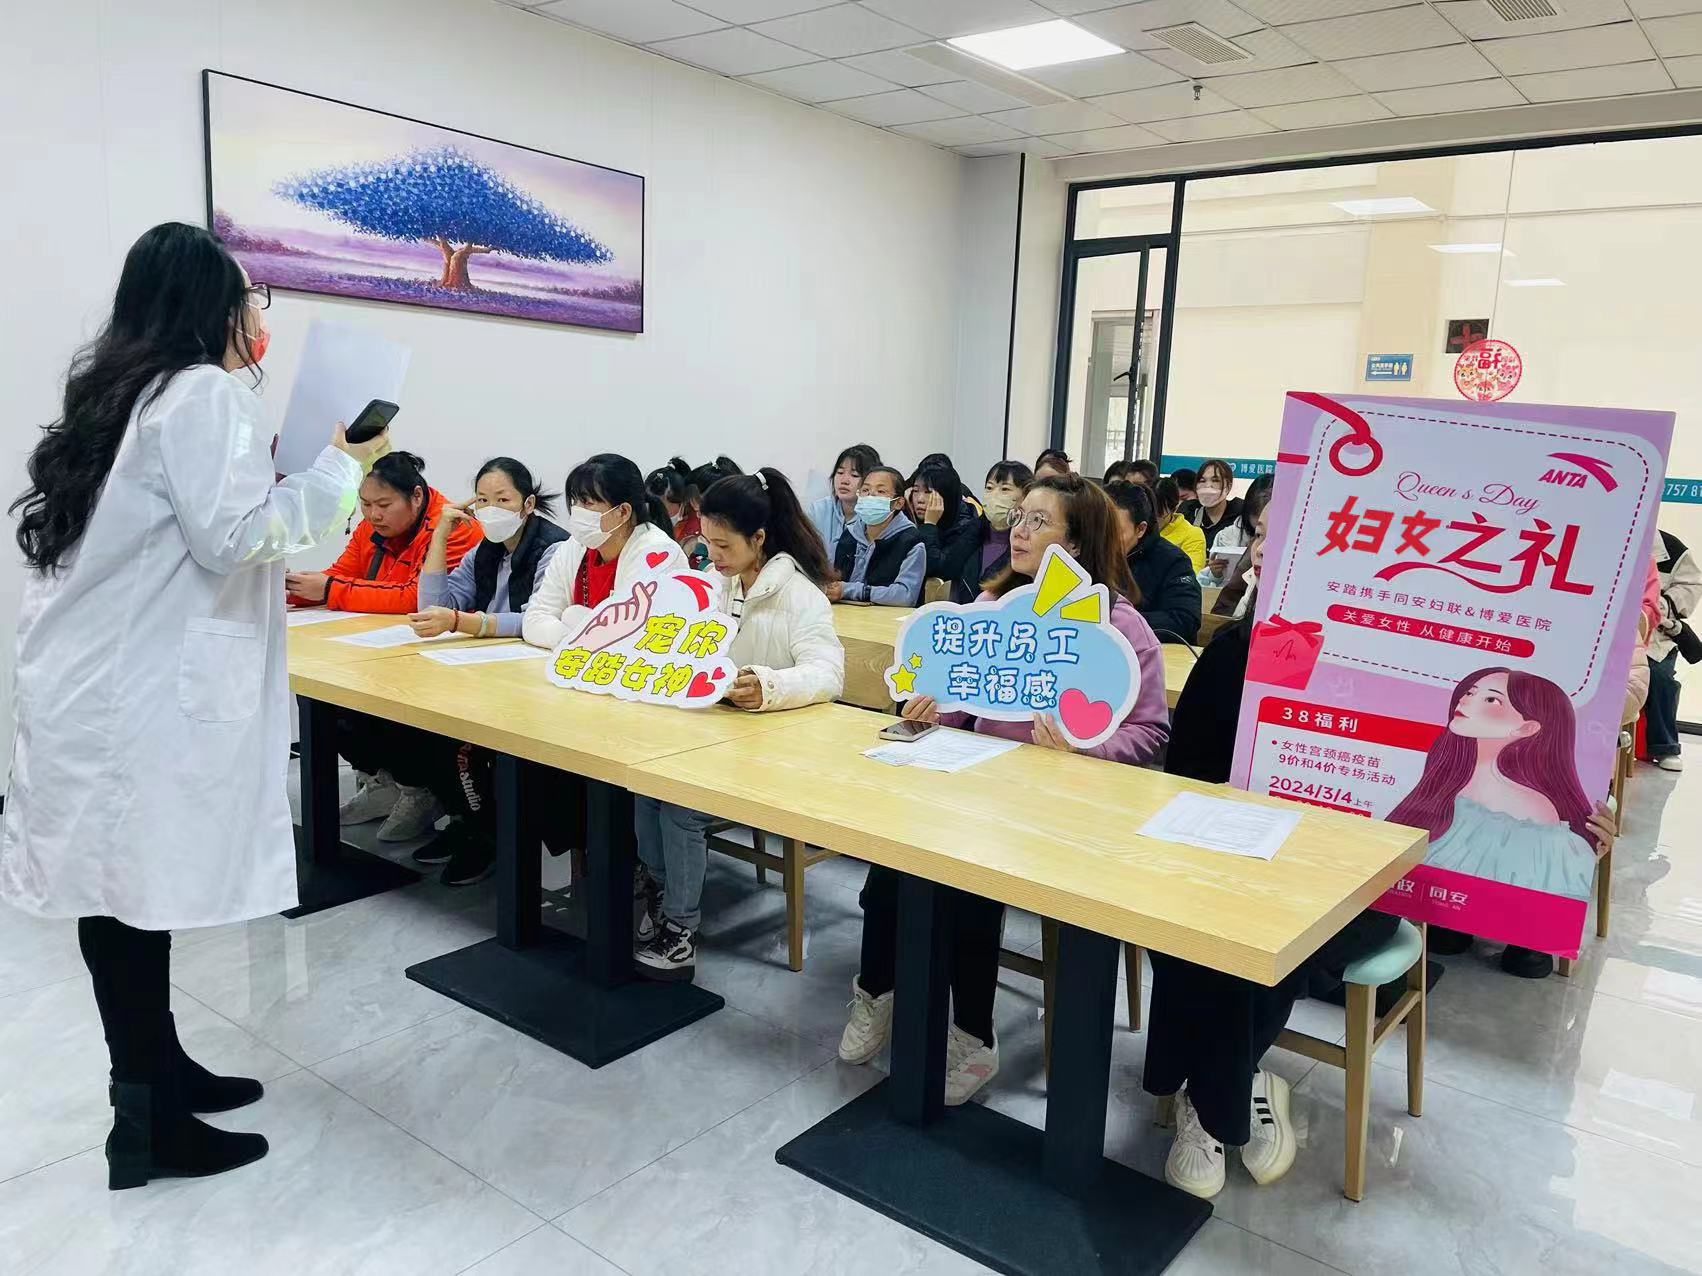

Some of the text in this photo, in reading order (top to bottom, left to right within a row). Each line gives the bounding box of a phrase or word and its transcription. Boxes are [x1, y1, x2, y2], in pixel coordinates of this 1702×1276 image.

[1240, 463, 1274, 474] 博爱医院
[1538, 469, 1588, 489] ANTA
[1394, 471, 1456, 501] Queen
[1478, 483, 1540, 515] Day
[1316, 495, 1594, 596] 妇女之礼
[1326, 580, 1553, 632] 安踏携手同安妇联&博爱医院
[634, 613, 728, 658] 宠你
[932, 615, 1079, 664] 提升员工
[1343, 609, 1512, 653] 关爱女性 从健康开始
[554, 646, 693, 697] 安踏女神
[948, 662, 1057, 710] 幸福感
[1282, 707, 1358, 733] 38福利
[1278, 754, 1396, 786] 9价和4价专场活动
[1281, 740, 1381, 768] 女性宫颈癌疫苗
[1429, 886, 1469, 906] 同安
